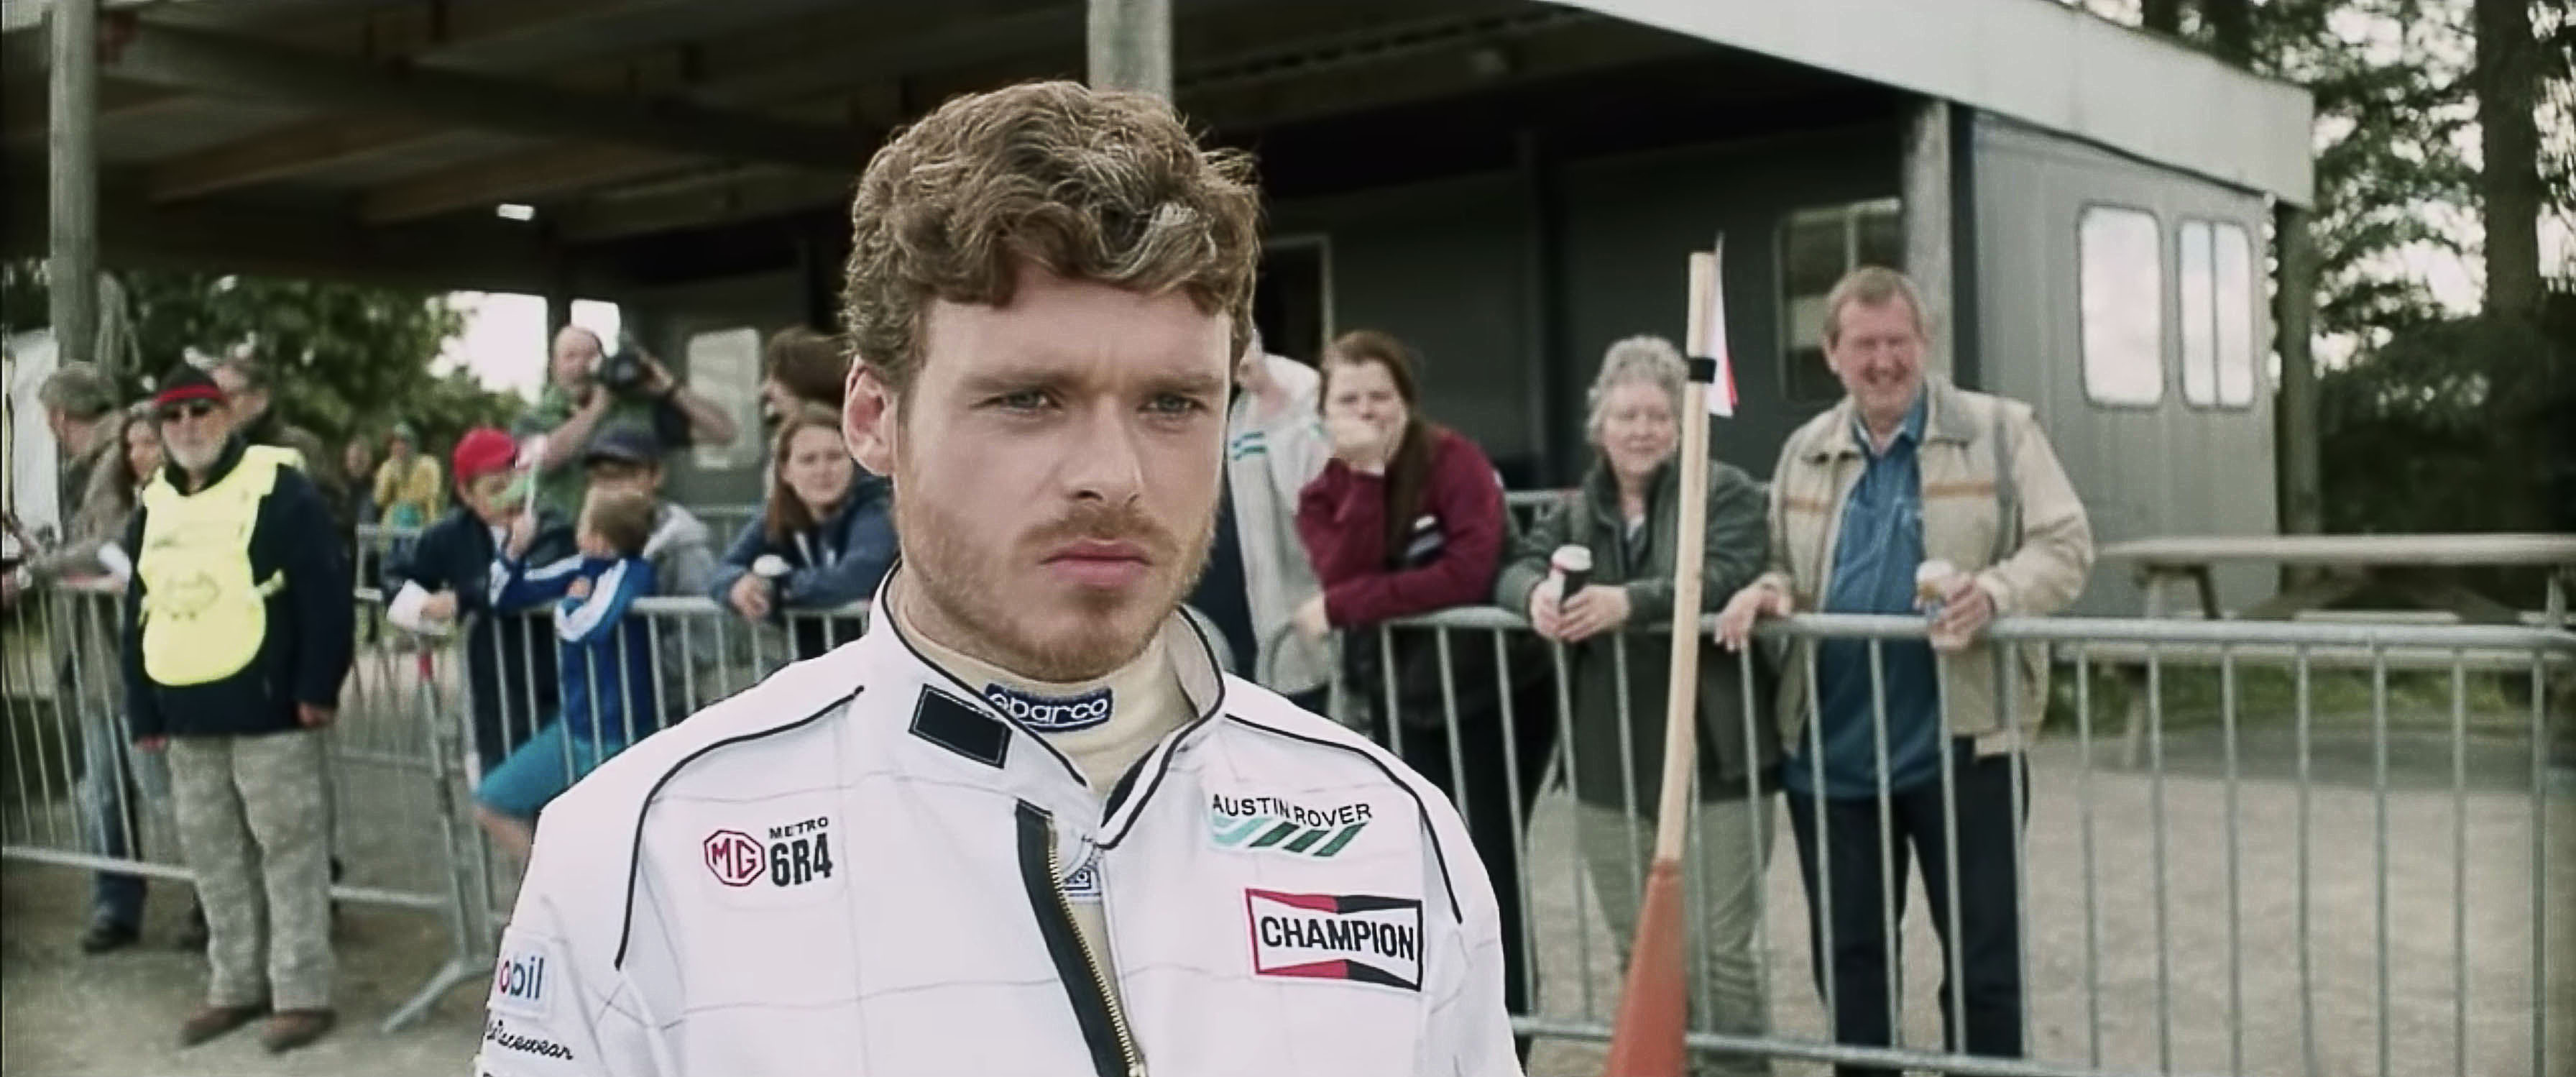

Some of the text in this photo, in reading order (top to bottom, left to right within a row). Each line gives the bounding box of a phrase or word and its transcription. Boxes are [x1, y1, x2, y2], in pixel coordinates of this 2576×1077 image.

[768, 816, 829, 840] METRO
[1213, 793, 1373, 828] AUSTIN ROVER
[711, 832, 833, 887] MG 6R4
[1261, 916, 1414, 962] CHAMPION
[499, 956, 544, 1000] obil
